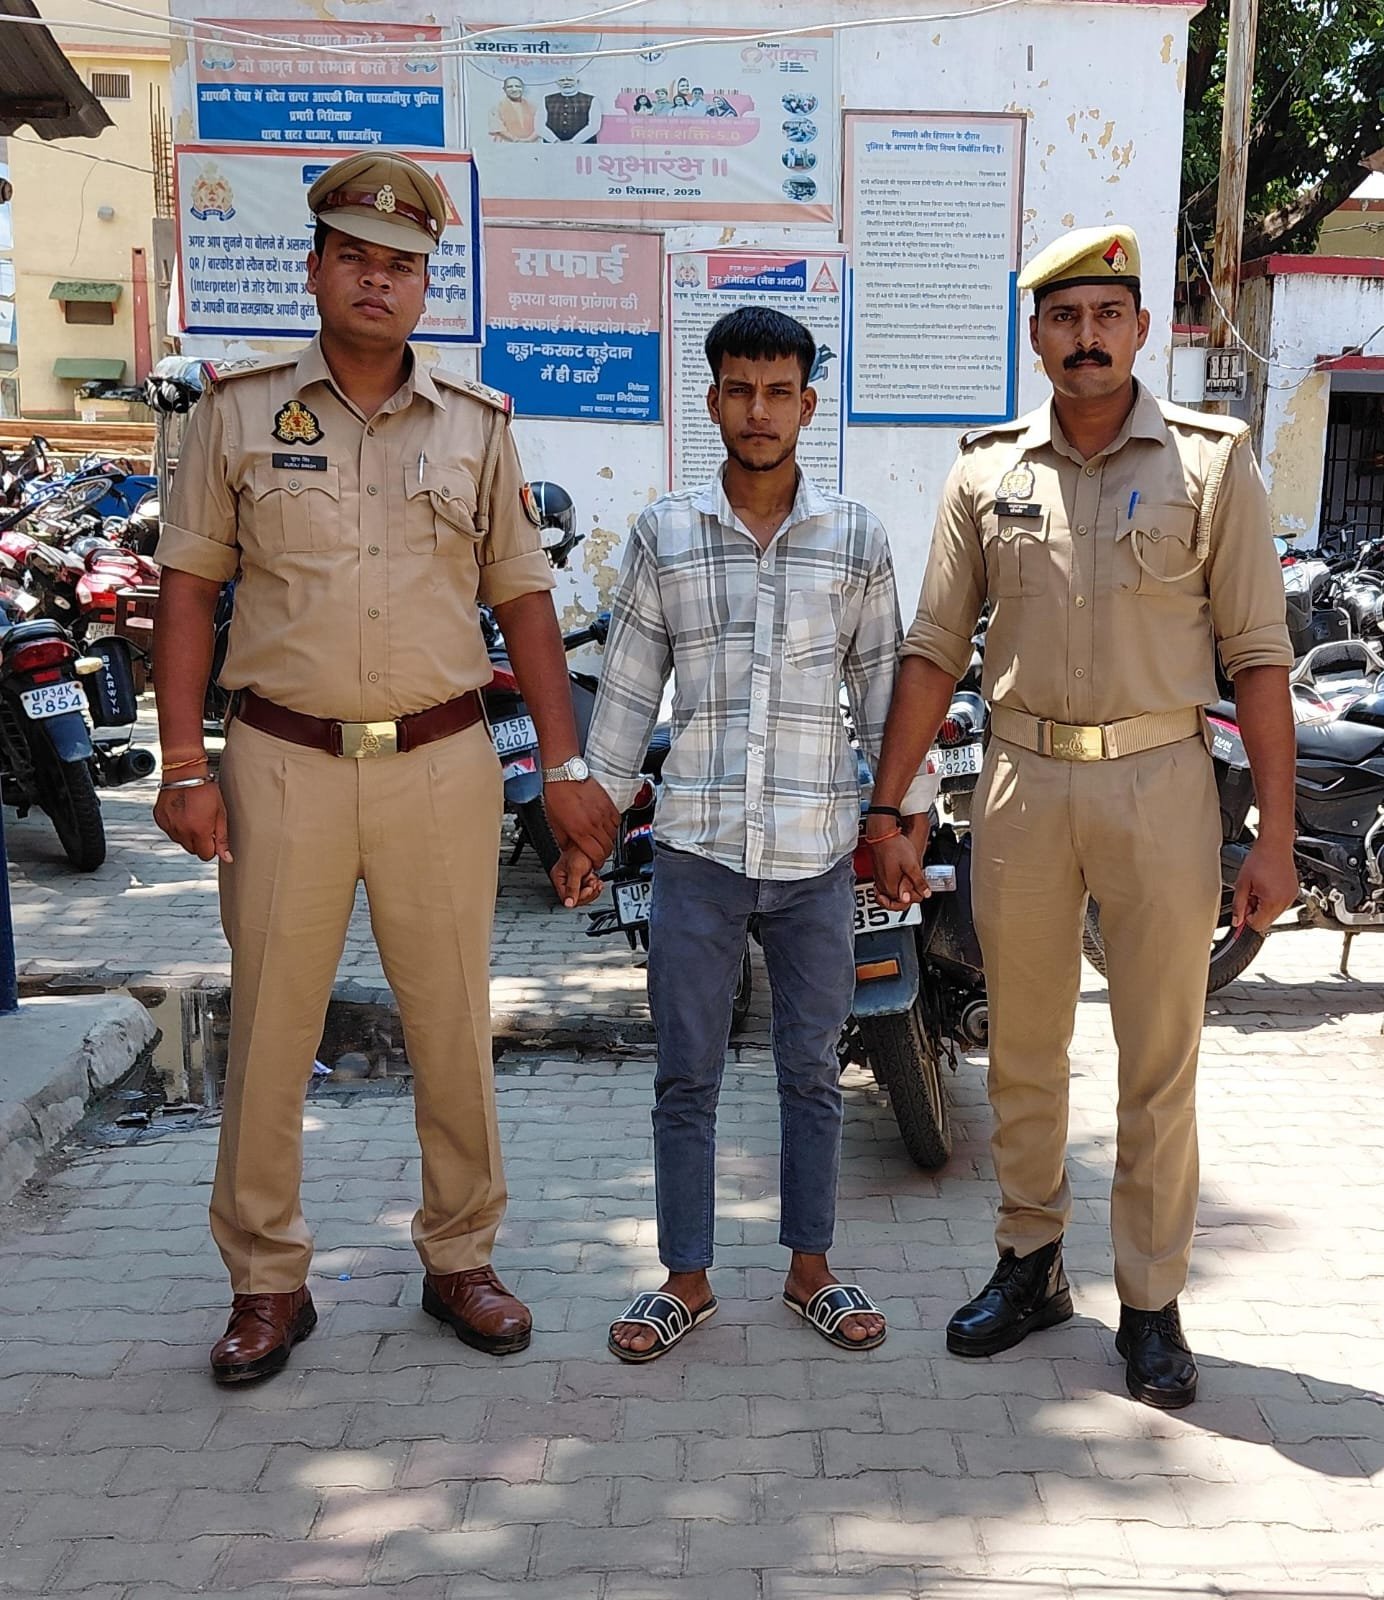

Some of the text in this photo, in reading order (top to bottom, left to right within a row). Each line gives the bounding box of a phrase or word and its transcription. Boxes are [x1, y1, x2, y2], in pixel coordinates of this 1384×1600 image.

[474, 41, 517, 54] सशक्त
[521, 40, 551, 54] नारी
[238, 56, 252, 73] जो
[259, 58, 292, 78] कानून
[297, 59, 313, 74] का
[319, 59, 355, 75] सम्मान
[359, 57, 386, 76] करते
[200, 88, 231, 102] आपकी
[234, 88, 252, 102] सेवा
[254, 88, 263, 102] में
[312, 89, 342, 103] आपकी
[413, 91, 440, 108] पुलिस
[261, 129, 281, 140] थाना
[283, 129, 302, 140] सदर
[597, 149, 705, 183] शुभारंभ
[608, 186, 622, 195] 20
[674, 187, 701, 196] 2025
[188, 234, 205, 248] अगर
[207, 235, 221, 249] आप
[223, 233, 242, 252] सुनने
[245, 235, 253, 249] या
[254, 233, 275, 250] बोलने
[287, 235, 313, 251] असमर्थ
[441, 240, 453, 257] दिए
[455, 244, 466, 257] गए
[189, 257, 200, 270] QR
[201, 255, 206, 273] /
[207, 255, 233, 271] बारकोड
[235, 255, 245, 271] को
[246, 254, 264, 272] स्कैन
[282, 259, 293, 273] यह
[440, 262, 466, 281] दुभाषिए
[512, 244, 630, 285] सफाई
[190, 278, 240, 295] (Interpreter)
[242, 279, 250, 294] से
[285, 282, 298, 295] आप
[445, 284, 466, 304] पुलिस
[777, 275, 804, 288] आदमी)
[190, 298, 315, 320] को आपकी बात समझाकर आपकी तुरंत
[508, 291, 638, 311] कृपया थाना प्रांगण की
[521, 315, 560, 334] सफाई
[562, 316, 576, 333] में
[578, 317, 624, 335] सहयोग
[627, 317, 651, 336] करें
[541, 364, 600, 384] में ही डालें
[31, 684, 74, 702] UP34K
[102, 655, 120, 715] STARWYN
[32, 694, 82, 716] 5854
[496, 731, 529, 750] 6407
[945, 759, 977, 774] 9228
